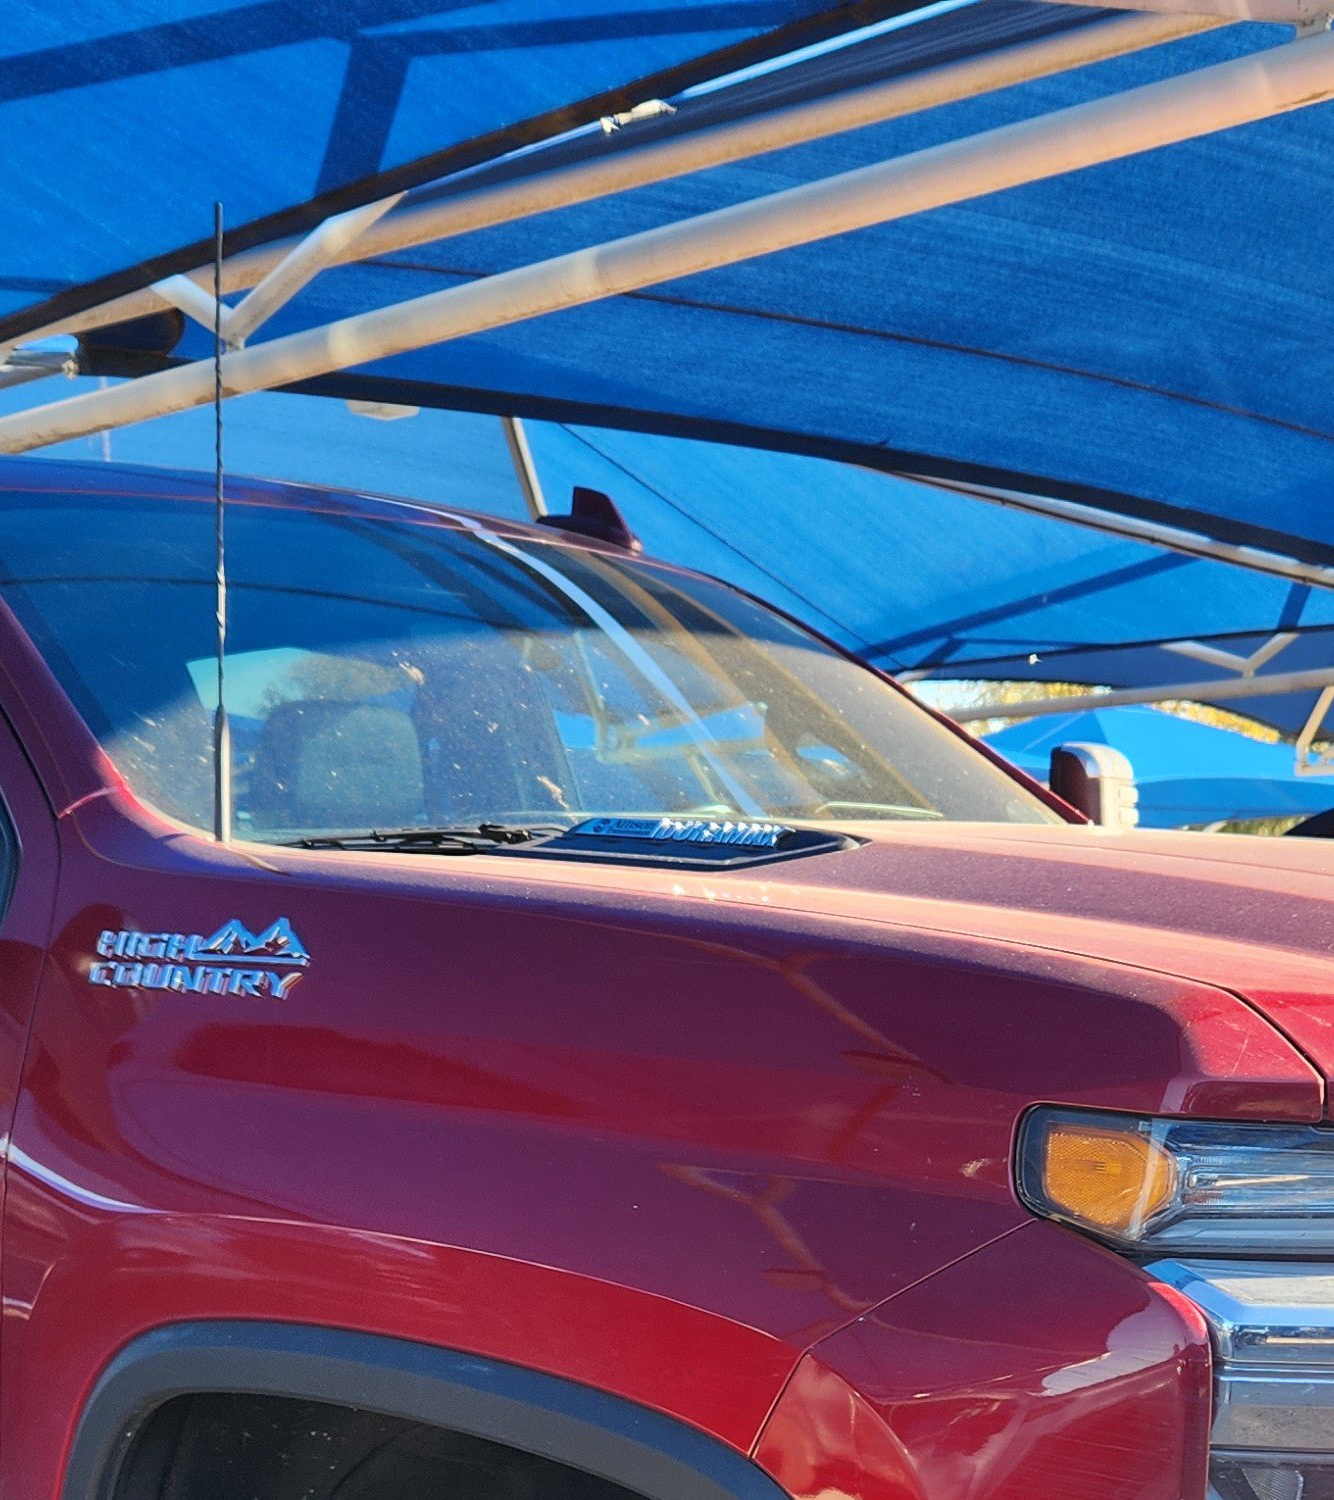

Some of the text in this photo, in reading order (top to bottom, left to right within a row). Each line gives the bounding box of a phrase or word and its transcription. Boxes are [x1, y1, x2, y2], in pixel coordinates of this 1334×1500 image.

[653, 818, 784, 848] DURAMAX
[96, 930, 206, 961] HIGH
[88, 961, 304, 1000] COUNTRY
